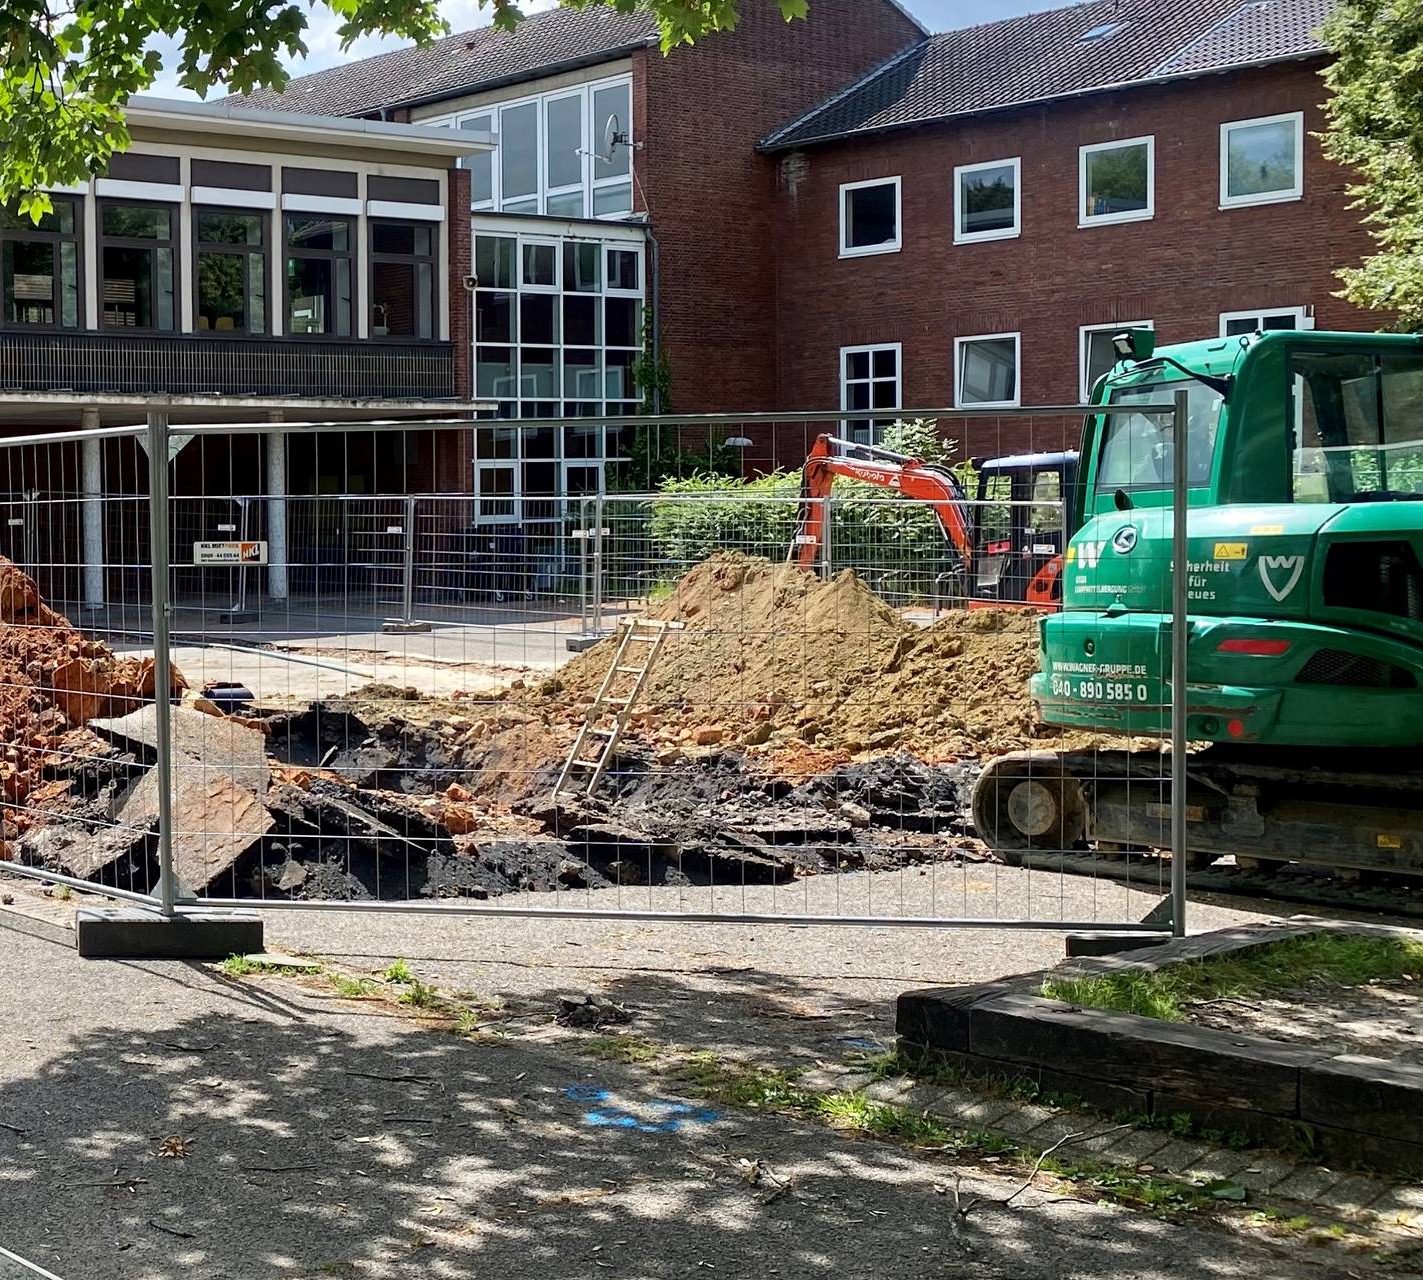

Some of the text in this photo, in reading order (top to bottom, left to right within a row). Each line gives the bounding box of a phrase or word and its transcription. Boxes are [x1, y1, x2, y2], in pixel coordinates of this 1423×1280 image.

[242, 543, 260, 559] HKL
[1170, 560, 1230, 572] Sherheit
[1188, 575, 1207, 587] für
[1187, 590, 1216, 600] eues
[1052, 662, 1147, 675] WWW.WAGNER-GRUPPE.DE
[1053, 680, 1071, 697] 040
[1080, 681, 1103, 699] 890
[1106, 683, 1133, 700] 585
[1137, 684, 1148, 701] 0
